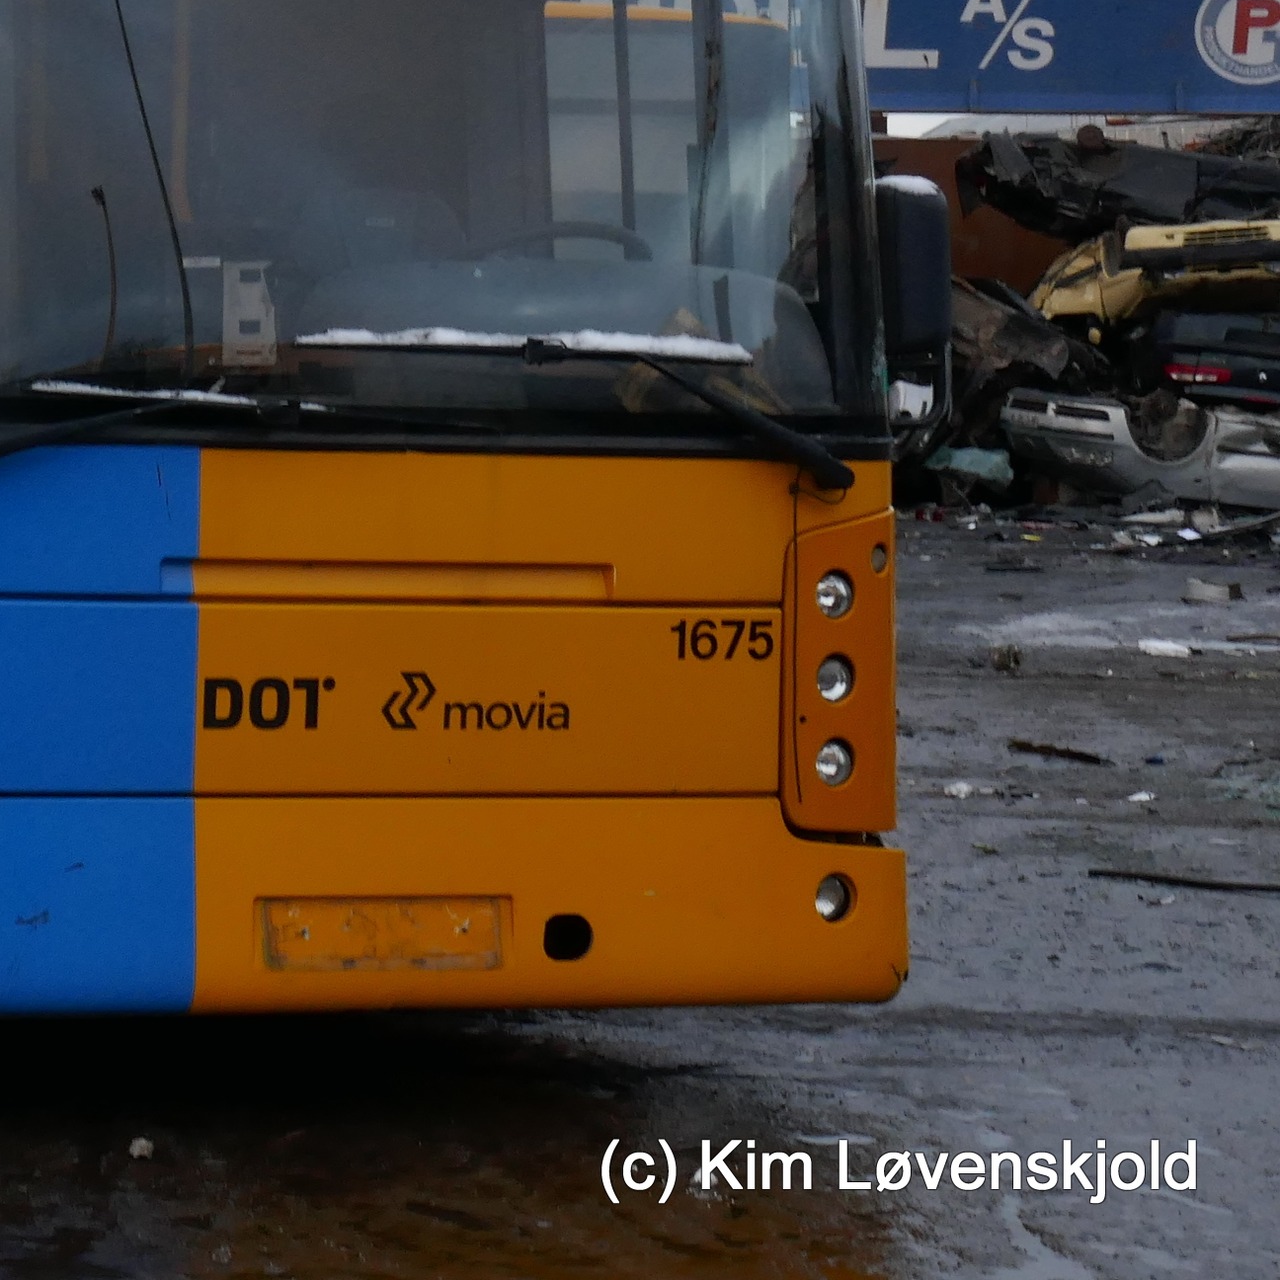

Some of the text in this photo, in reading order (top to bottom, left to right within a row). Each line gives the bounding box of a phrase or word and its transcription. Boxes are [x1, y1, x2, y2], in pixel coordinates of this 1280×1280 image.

[670, 619, 775, 661] 1675
[203, 676, 336, 731] DOT
[442, 690, 571, 731] movia
